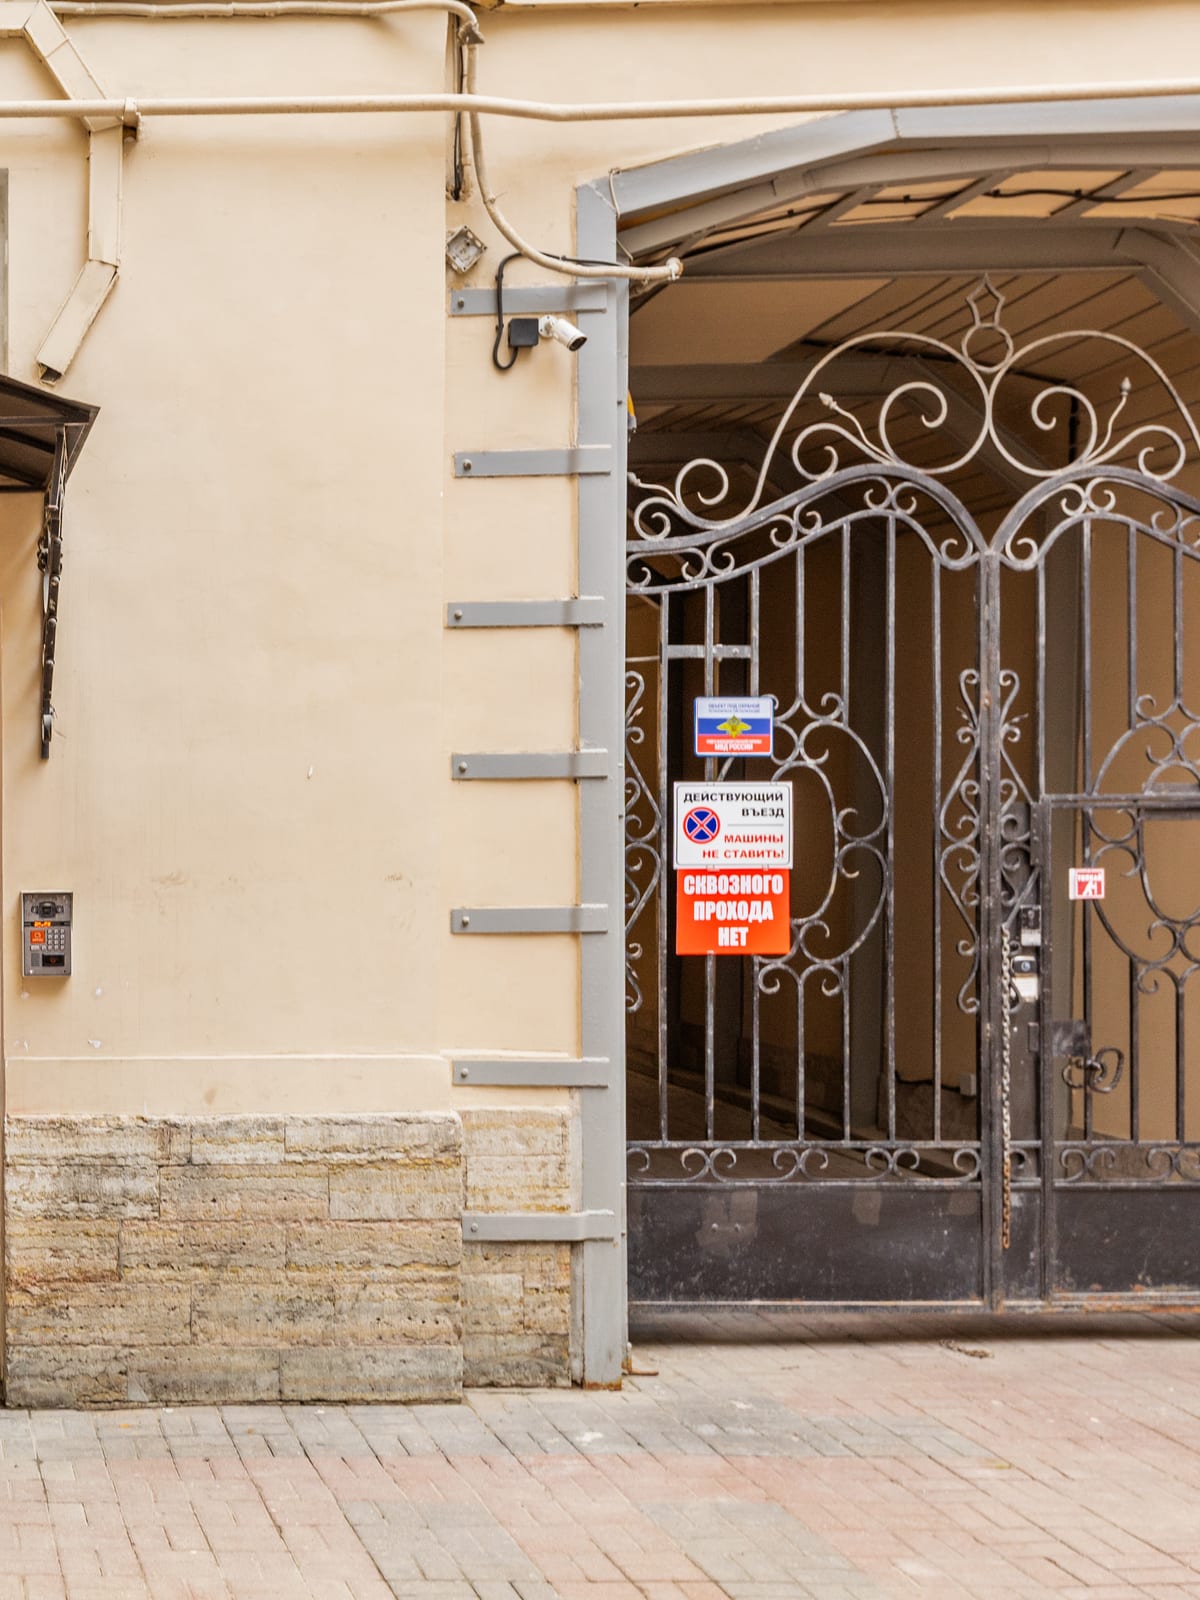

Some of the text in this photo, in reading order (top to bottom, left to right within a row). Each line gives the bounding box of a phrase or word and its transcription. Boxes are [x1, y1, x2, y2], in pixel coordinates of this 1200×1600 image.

[683, 792, 784, 803] ДЕЙСТВУЮЩИЙ
[741, 808, 785, 818] ВЪЕЗД
[724, 834, 784, 844] МАШИНЫ
[702, 850, 785, 859] НЕ СТАВИТЬ!
[683, 874, 784, 895] СКВОЗНОГО
[693, 900, 774, 923] ПРОХОДА
[717, 926, 749, 947] НЕТ
